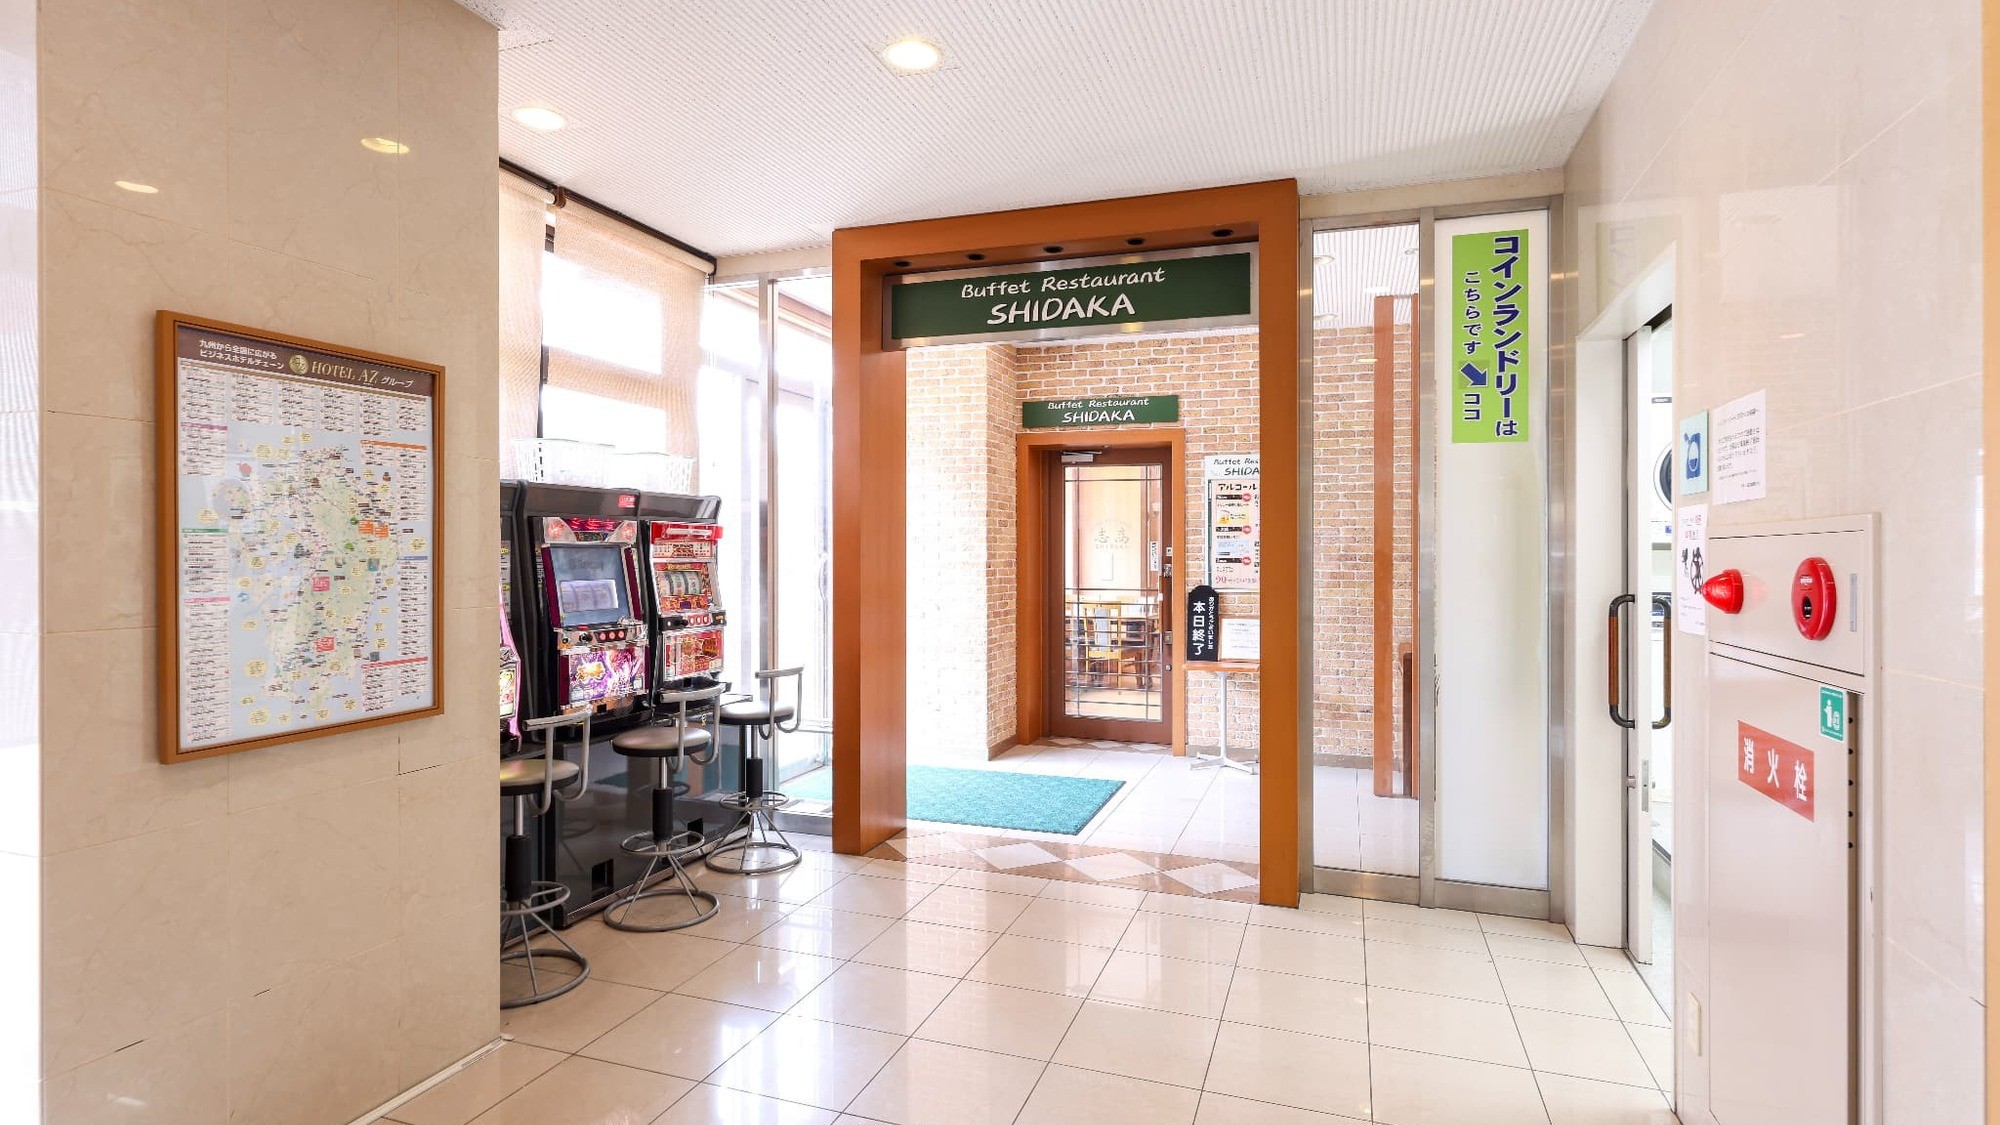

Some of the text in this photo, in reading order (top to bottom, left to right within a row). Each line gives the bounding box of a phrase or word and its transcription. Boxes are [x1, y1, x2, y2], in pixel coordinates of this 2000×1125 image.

[961, 266, 1166, 299] Buffet Restaurant
[986, 293, 1136, 326] SHIDAKA
[199, 339, 278, 360] 九州から全国に広がる
[1463, 271, 1483, 422] こちらです ココ
[1490, 235, 1523, 437] コインランドリーは
[199, 349, 285, 370] ビジネスホテルチェーン
[311, 361, 415, 389] HOTEL AZ グループ
[1047, 397, 1150, 410] Buffet Restaurant
[1061, 408, 1136, 423] SHIDAKA
[1192, 600, 1206, 656] 本日終了
[1743, 737, 1808, 802] 消火栓
